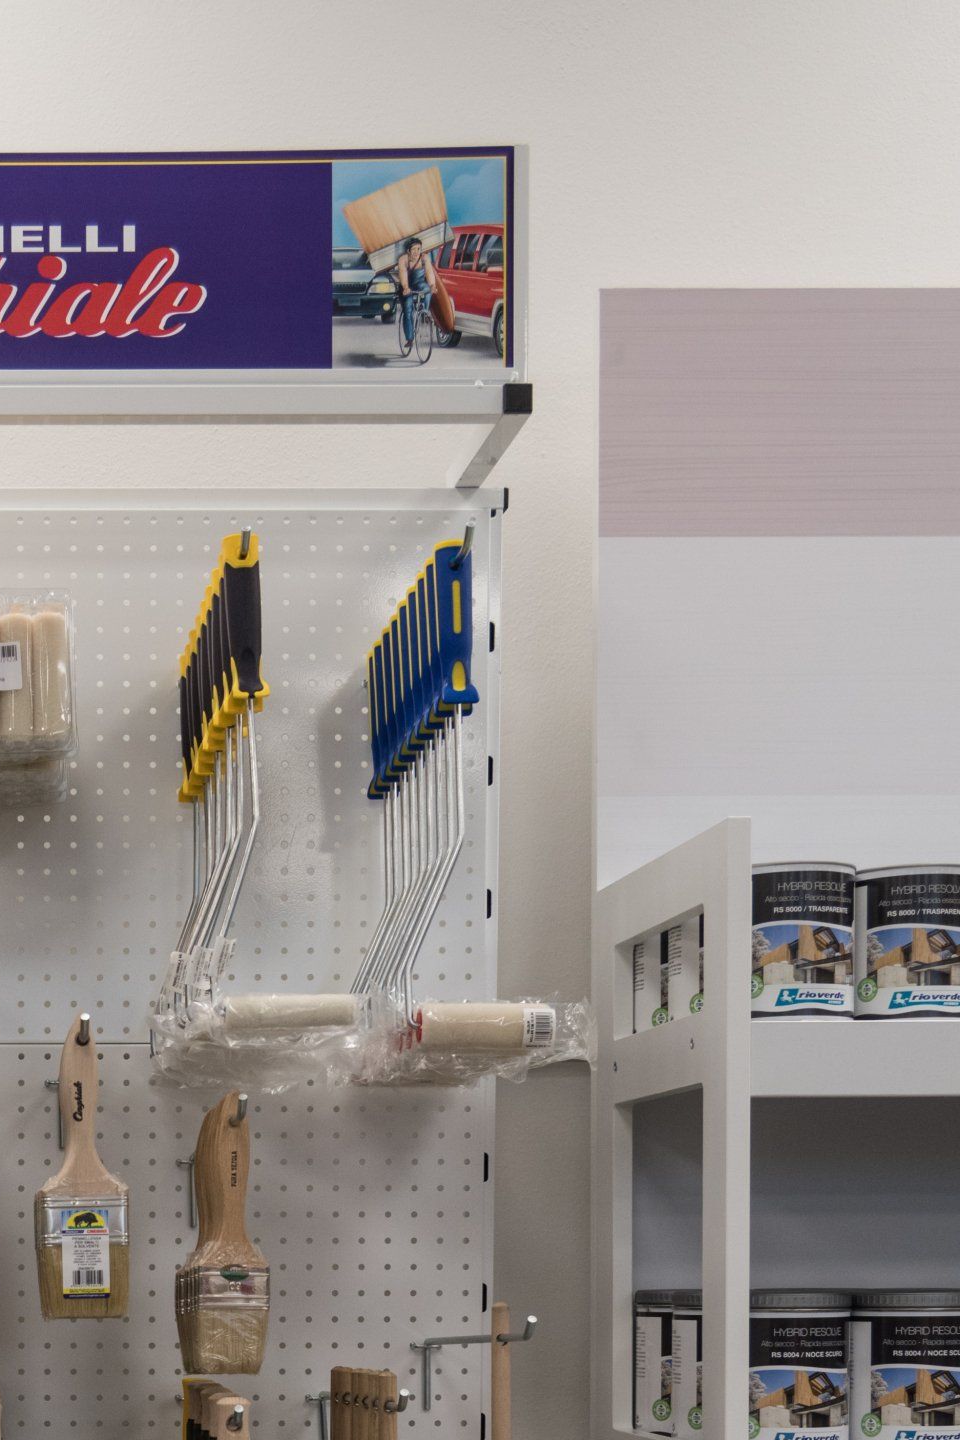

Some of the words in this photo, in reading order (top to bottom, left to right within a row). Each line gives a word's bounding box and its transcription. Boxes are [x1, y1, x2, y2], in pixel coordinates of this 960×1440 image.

[777, 881, 813, 891] HYBRID
[815, 881, 846, 892] RESOLVE
[891, 884, 927, 895] HYBRID
[765, 895, 777, 903] Alto
[804, 894, 826, 902] Rapida
[773, 906, 784, 914] RS
[785, 905, 802, 913] 8000
[808, 905, 849, 915] TRASPARENTE
[887, 909, 898, 918] RS
[898, 909, 916, 917] 8000
[72, 1081, 83, 1122] Cinghiale
[773, 1327, 808, 1337] HYBRID
[810, 1327, 843, 1337] RESOLVE
[895, 1326, 930, 1336] HYBRID
